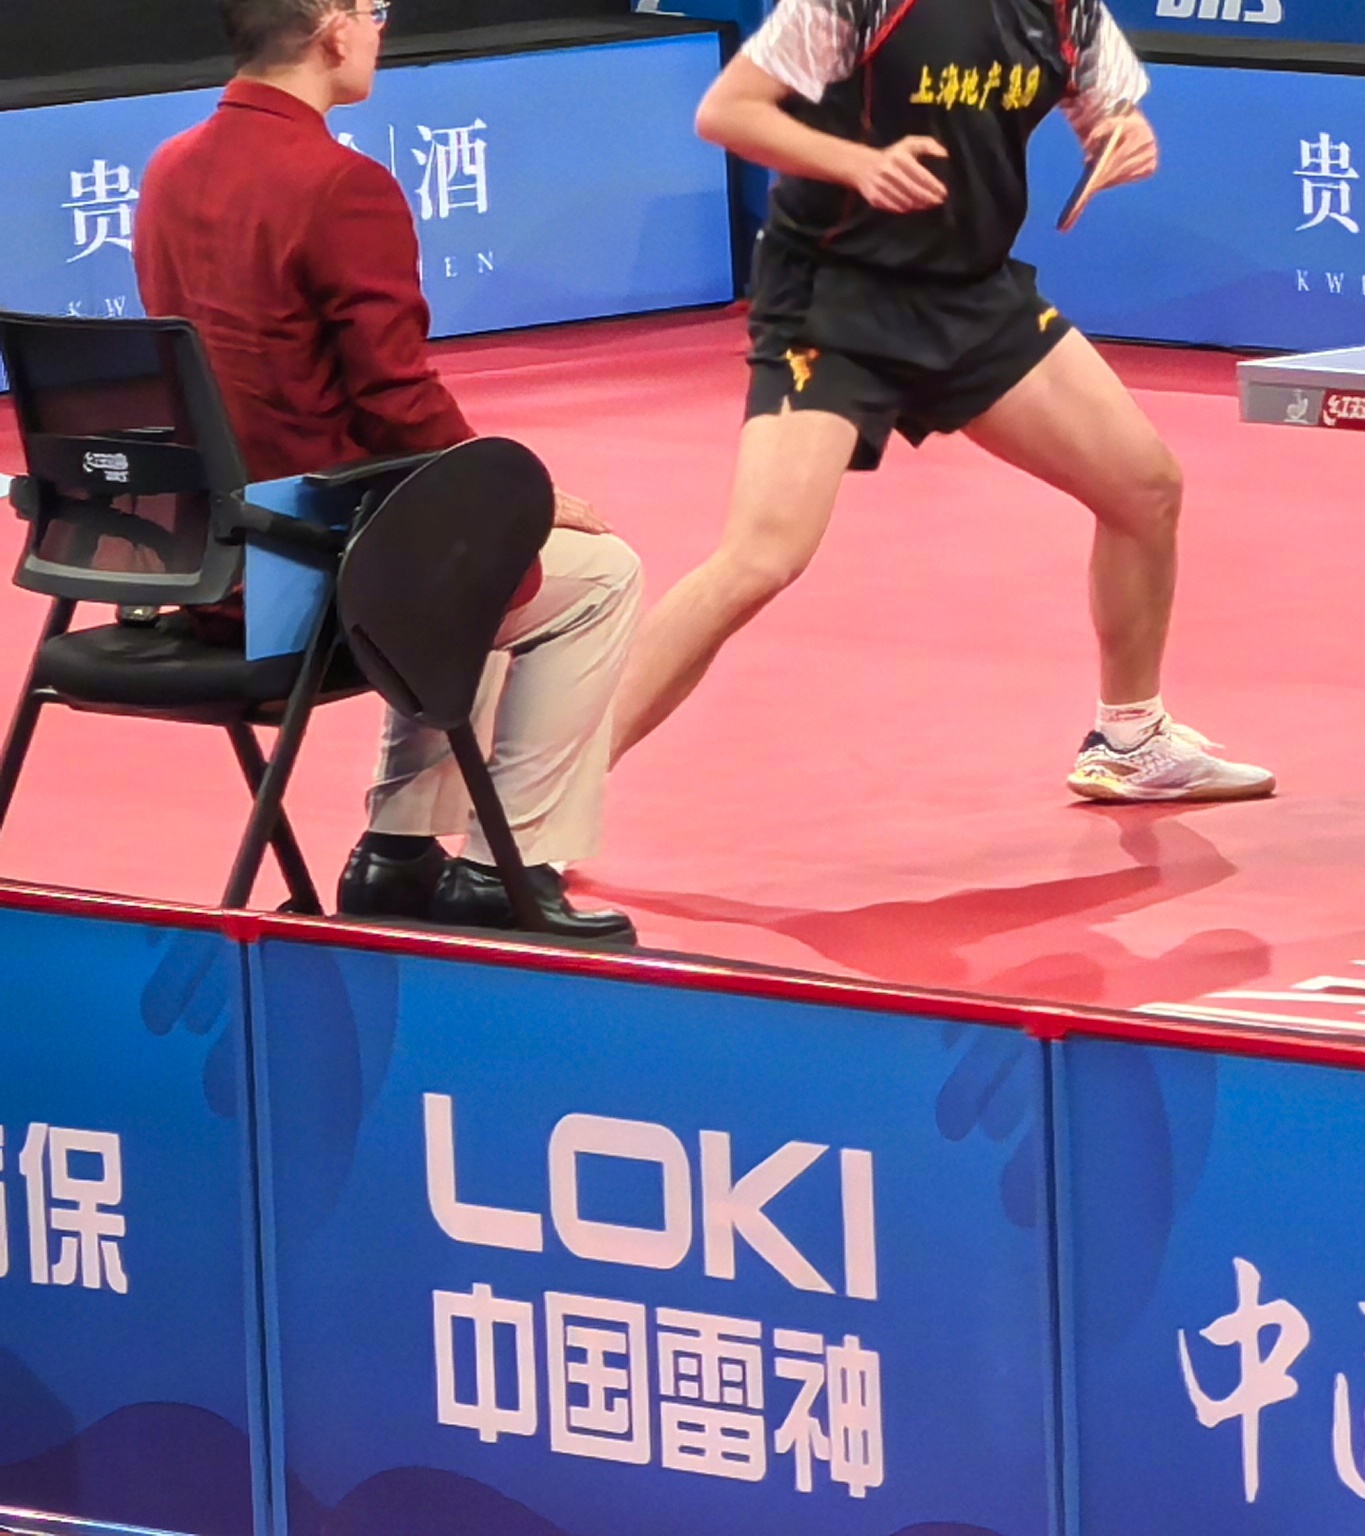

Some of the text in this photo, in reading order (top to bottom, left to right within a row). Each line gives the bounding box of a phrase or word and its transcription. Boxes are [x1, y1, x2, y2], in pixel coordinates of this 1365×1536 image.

[0, 1121, 128, 1295] 保
[424, 1092, 878, 1301] LOKI
[432, 1281, 885, 1499] 中国雷神
